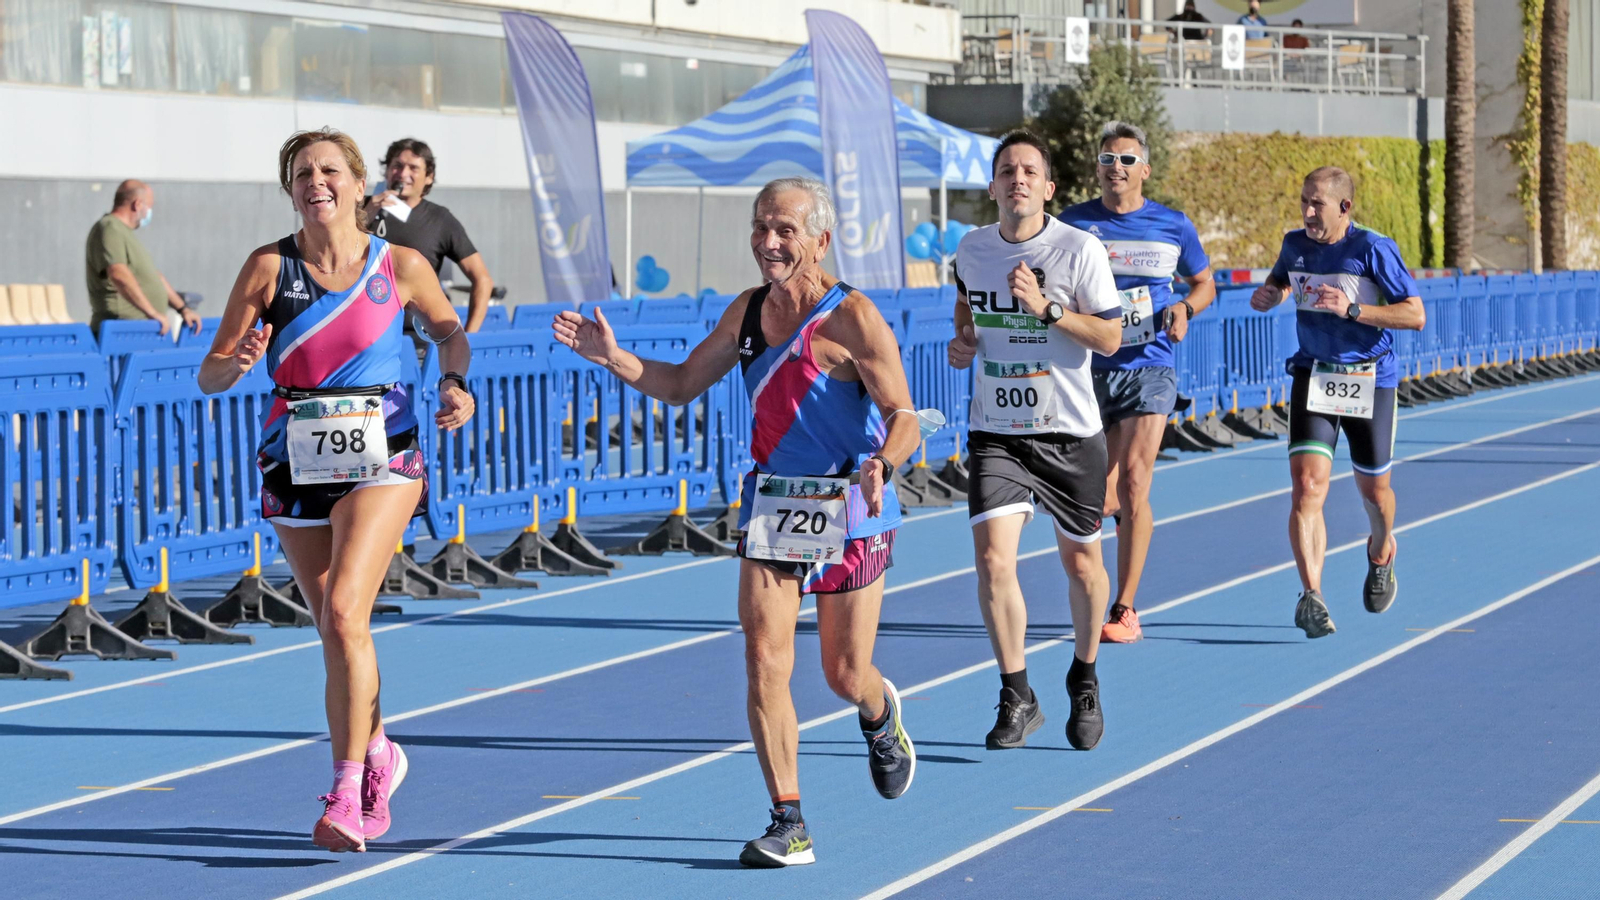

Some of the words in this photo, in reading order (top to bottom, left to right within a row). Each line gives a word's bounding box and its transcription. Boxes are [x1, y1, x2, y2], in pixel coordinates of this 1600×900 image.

[1124, 250, 1161, 258] Triatlón
[1124, 257, 1160, 267] Xerez
[284, 290, 310, 300] VIATOR
[1009, 335, 1047, 344] 2020
[1325, 381, 1361, 399] 832
[996, 387, 1038, 408] 800
[311, 428, 366, 455] 798
[776, 508, 827, 535] 720
